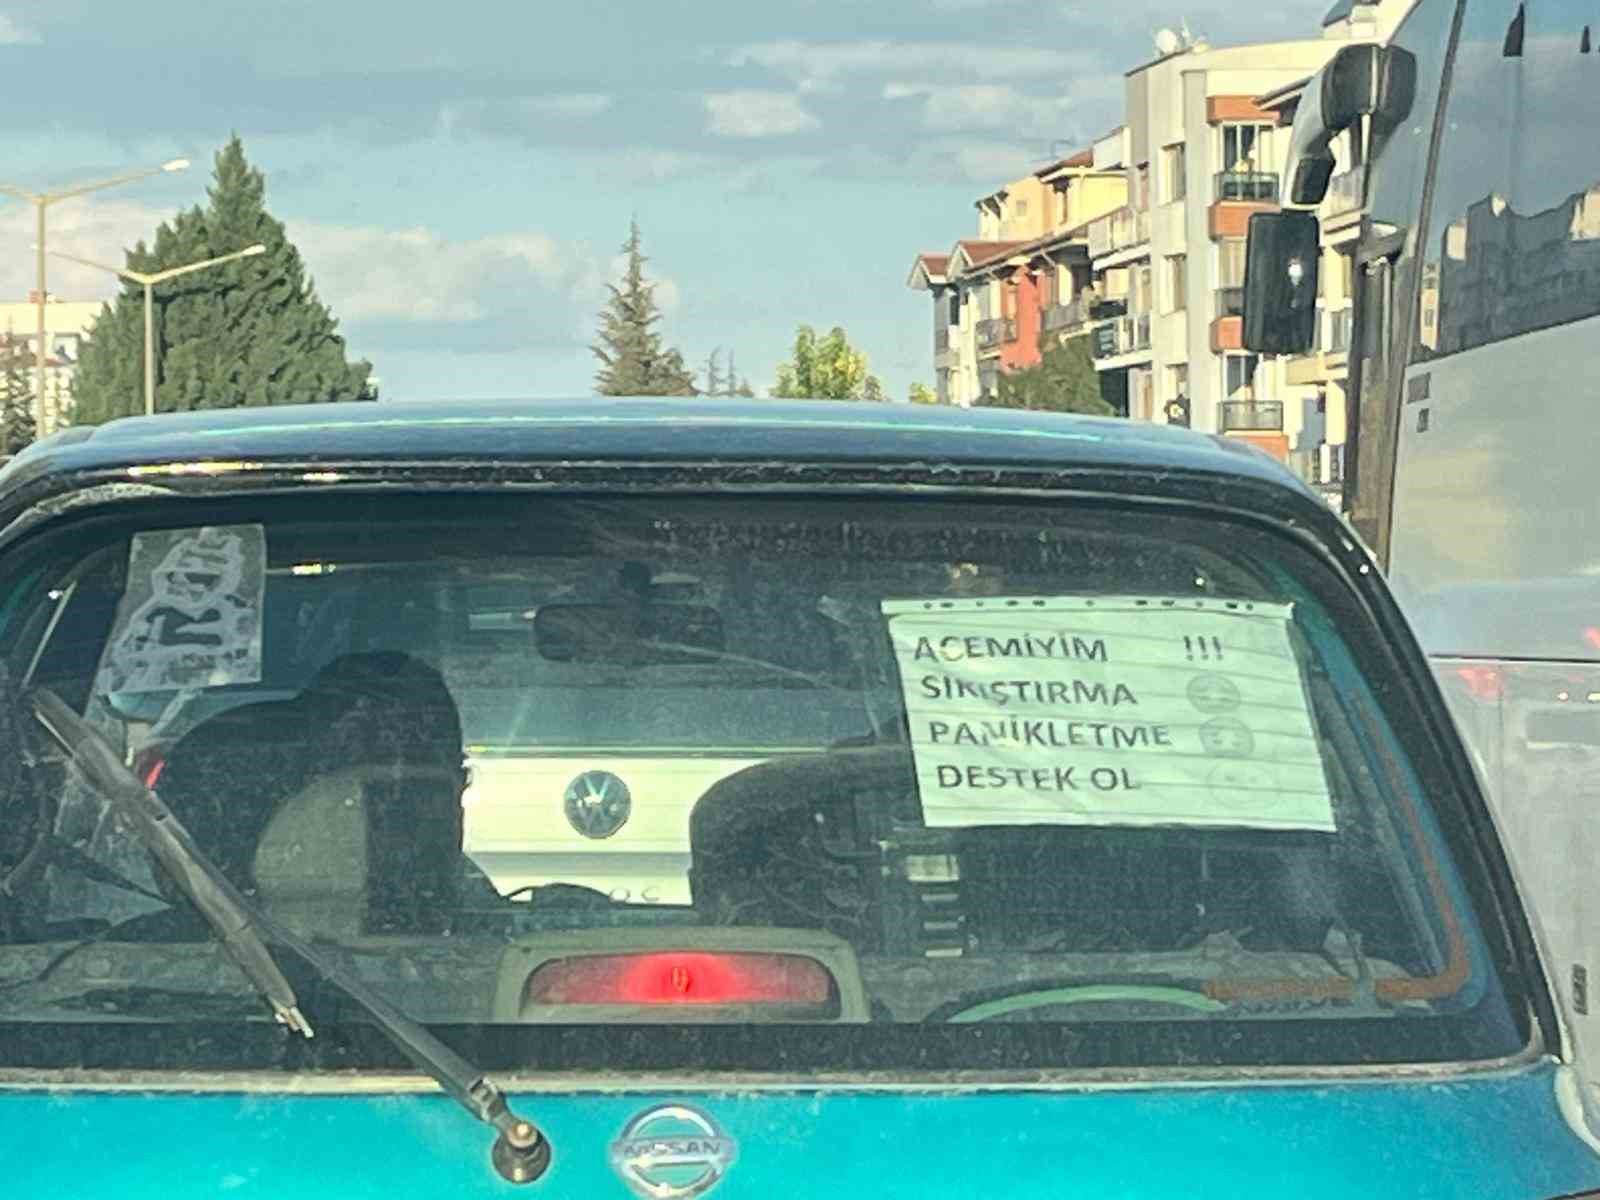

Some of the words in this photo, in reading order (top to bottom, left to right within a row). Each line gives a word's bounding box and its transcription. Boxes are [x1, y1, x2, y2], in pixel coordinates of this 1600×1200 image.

[913, 632, 1108, 663] ACEMİYİM
[921, 675, 1138, 706] SIKIŞTIRMA
[929, 714, 1173, 749] PANİKLETME
[937, 764, 1076, 792] DESTEK
[1090, 766, 1141, 792] OL
